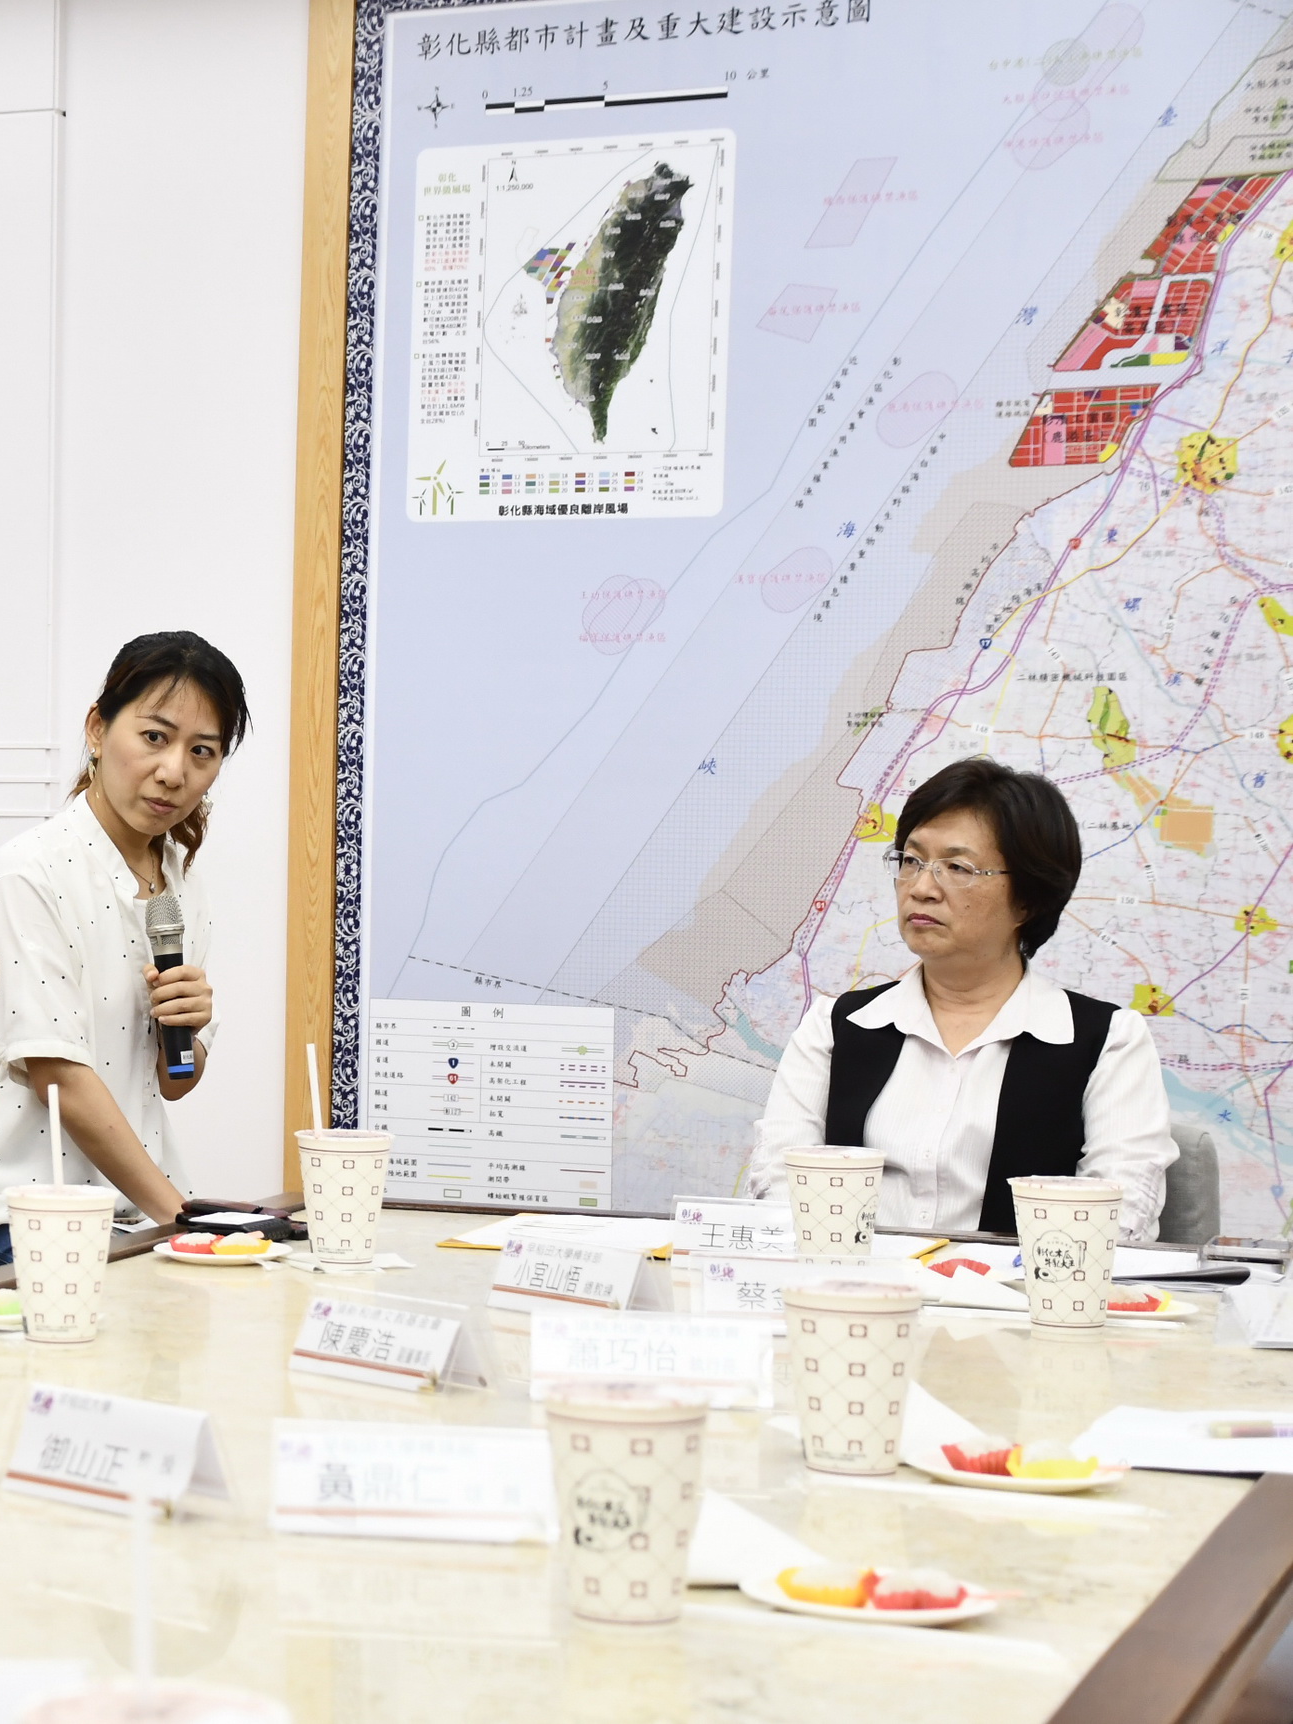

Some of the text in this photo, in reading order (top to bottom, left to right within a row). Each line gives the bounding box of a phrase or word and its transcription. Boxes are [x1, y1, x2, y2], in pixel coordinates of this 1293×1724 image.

[416, 0, 871, 61] 彰化縣都市計畫及重大建設示意圖
[481, 67, 769, 99] 0 1.25 5 10 公里
[438, 172, 457, 182] 彰化
[808, 356, 858, 427] 近岸海域範圍
[498, 502, 629, 517] 彰化縣海域優良離岸風場
[837, 521, 857, 538] 海
[697, 757, 717, 776] 峽
[474, 976, 503, 989] 縣市界
[461, 1006, 504, 1019] 圖 例
[374, 1071, 404, 1080] 快速道路
[489, 1077, 527, 1086] 高架化工程
[388, 1158, 418, 1167] 海域範圍
[388, 1170, 418, 1178] 陸地範圍
[699, 1222, 785, 1252] 王惠美
[514, 1258, 583, 1293] 小宮山悟
[318, 1320, 396, 1361] 陳慶浩
